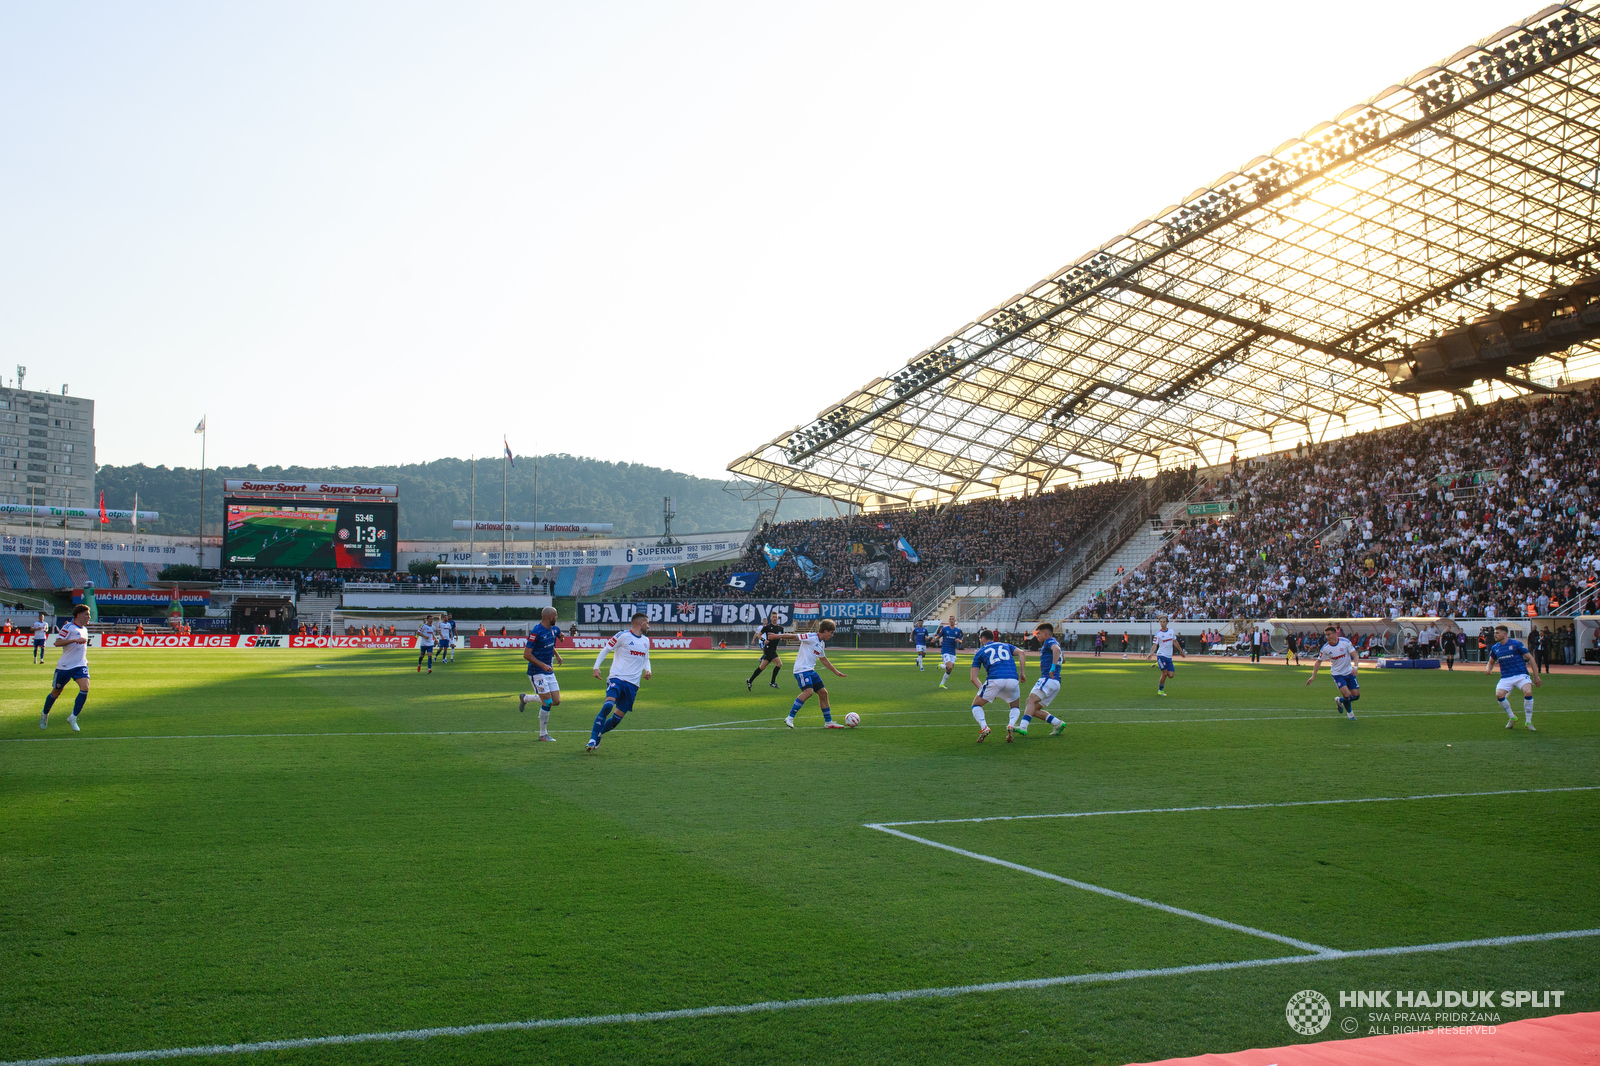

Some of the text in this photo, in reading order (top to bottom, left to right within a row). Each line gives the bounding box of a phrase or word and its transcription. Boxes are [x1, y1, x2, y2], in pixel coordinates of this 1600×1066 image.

[241, 482, 306, 492] SuperSport
[318, 484, 382, 495] SuperSport
[355, 514, 374, 522] 53:46
[438, 554, 449, 564] 17
[626, 547, 682, 562] 6 SUPERKUP
[81, 592, 112, 601] NVIJAČ
[584, 604, 637, 623] BAD
[821, 604, 879, 617] PURGERI
[106, 636, 190, 646] SPONZOR
[194, 636, 231, 646] LIGE
[490, 638, 527, 647] TOMMY
[652, 639, 692, 648] TOMMY
[984, 645, 1010, 665] 26
